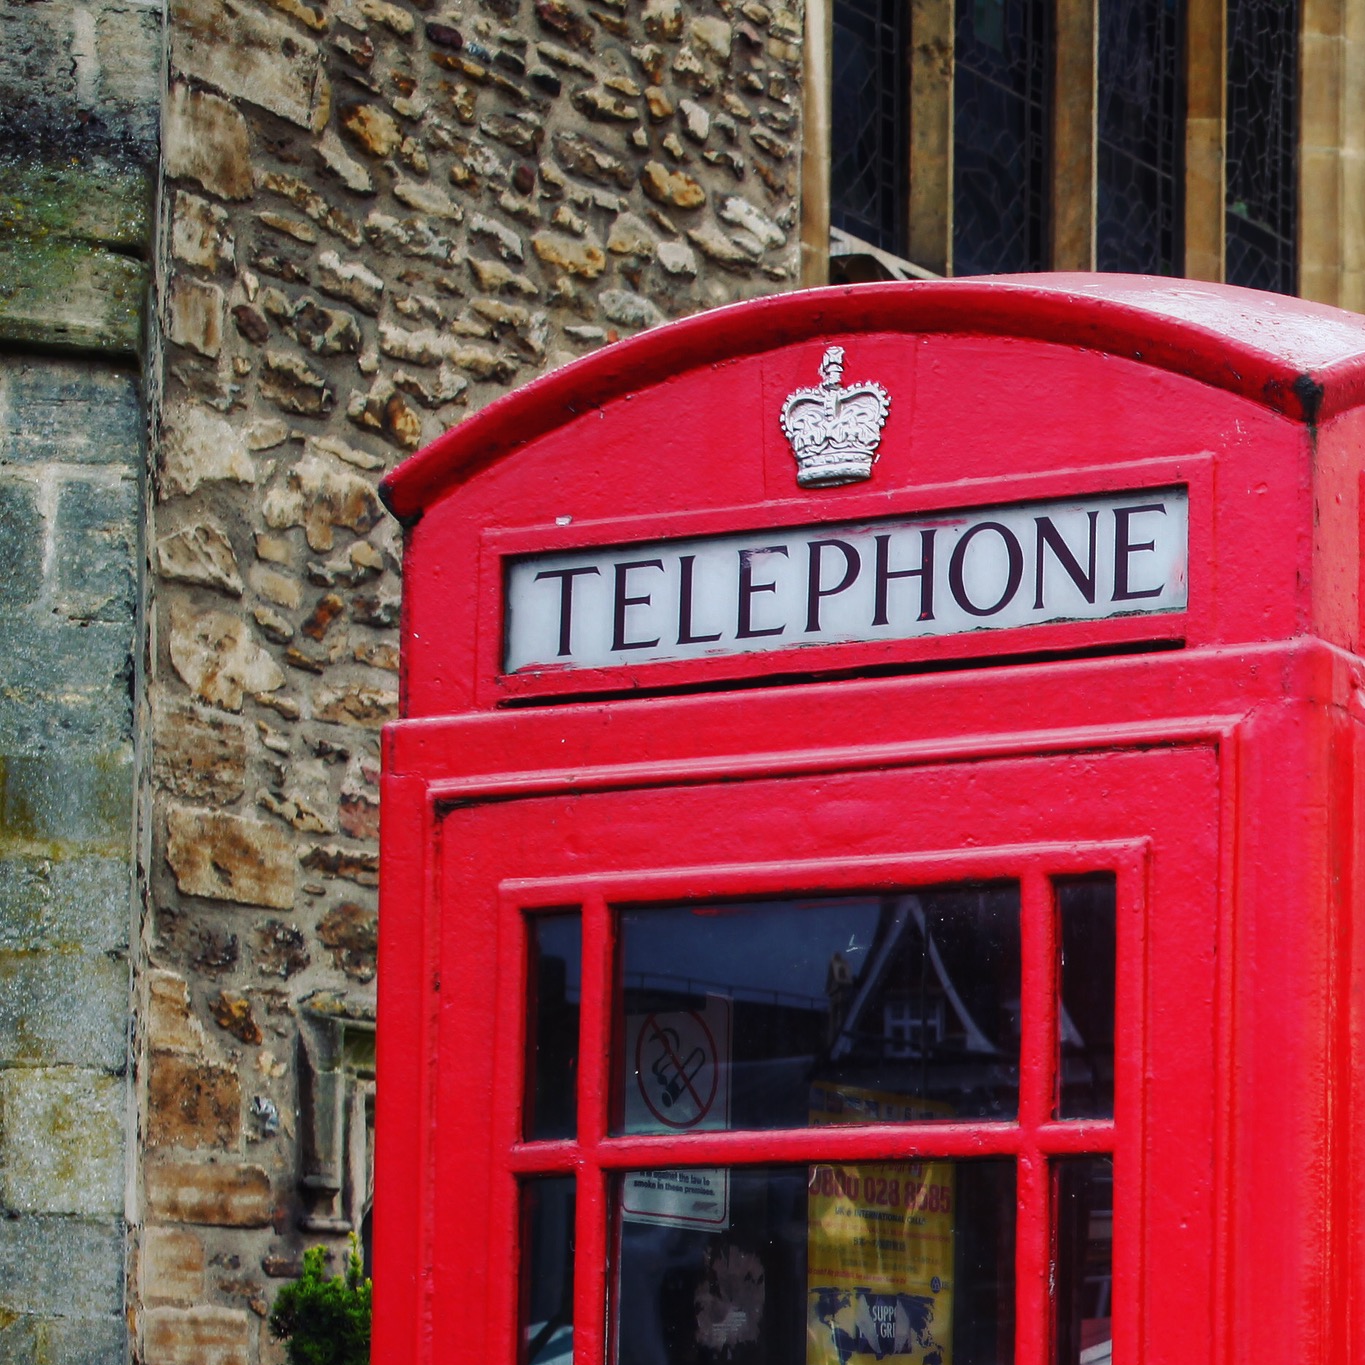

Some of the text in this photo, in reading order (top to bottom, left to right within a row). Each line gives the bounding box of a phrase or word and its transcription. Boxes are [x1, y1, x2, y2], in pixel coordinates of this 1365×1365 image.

[535, 502, 1167, 657] TELEPHONE
[703, 1176, 710, 1186] to
[864, 1177, 900, 1207] 028
